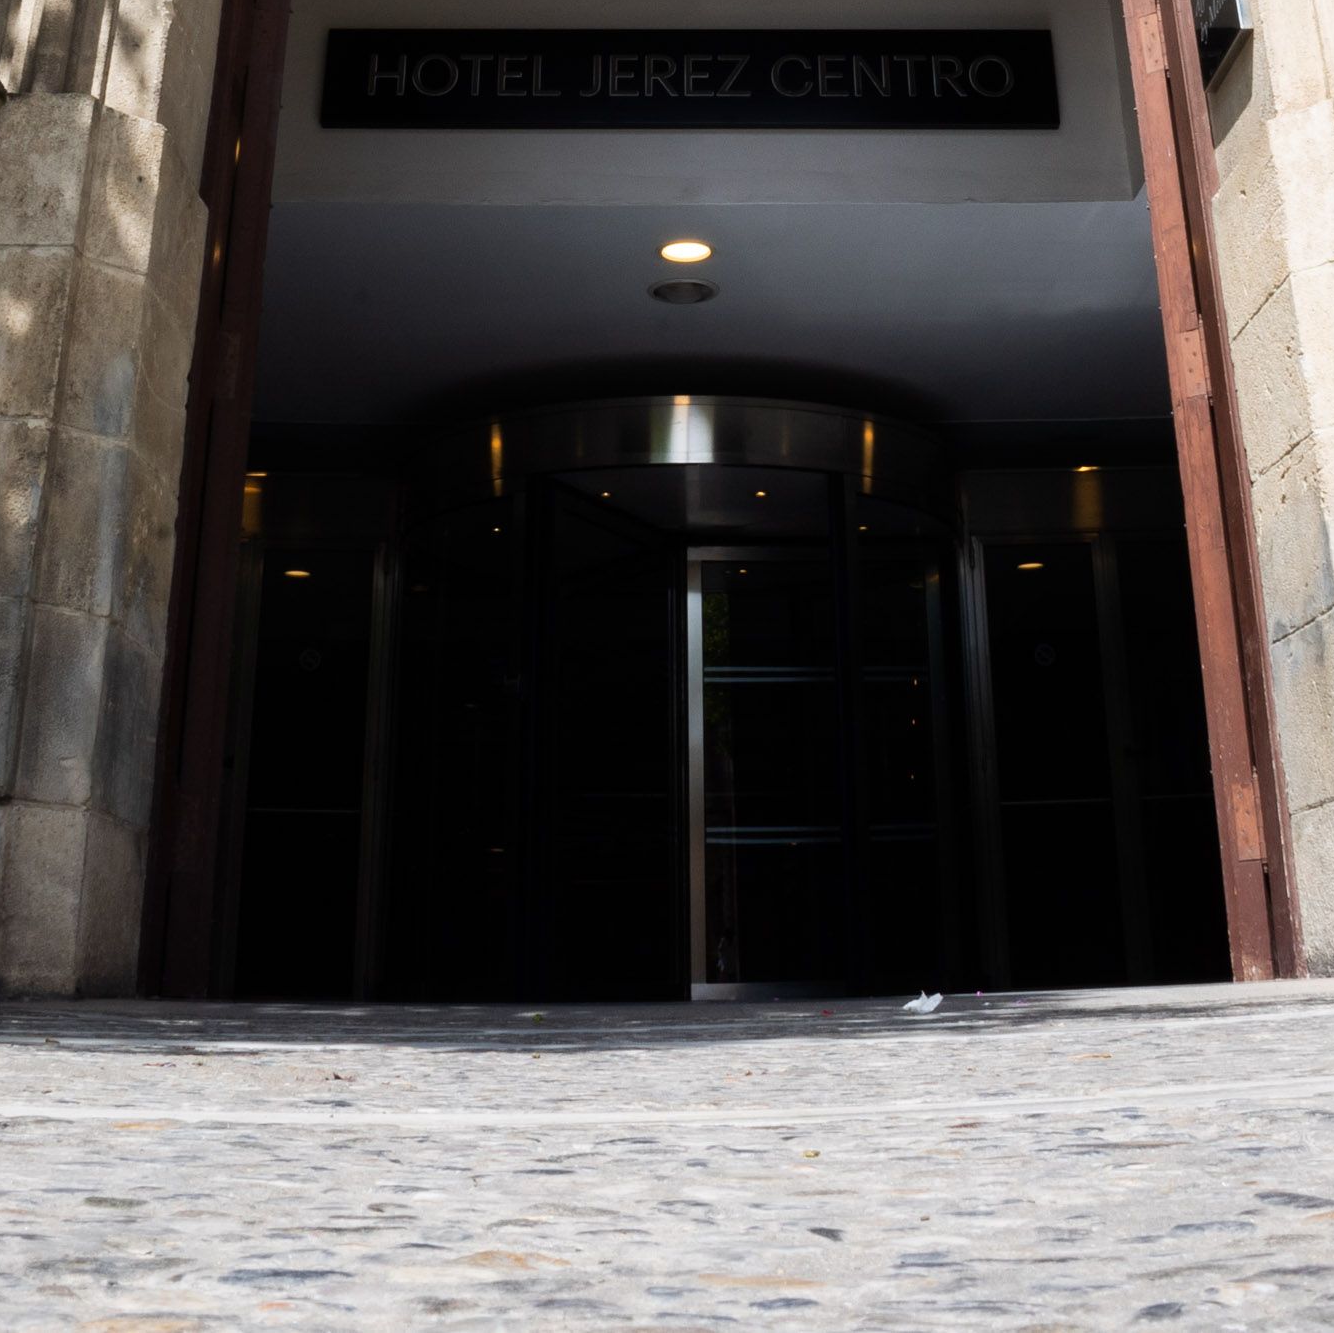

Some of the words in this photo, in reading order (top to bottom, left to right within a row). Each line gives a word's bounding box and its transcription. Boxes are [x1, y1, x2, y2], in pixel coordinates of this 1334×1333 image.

[367, 54, 562, 98] HOTEL
[579, 54, 753, 98] JEREZ
[770, 54, 1016, 98] CENTRO
